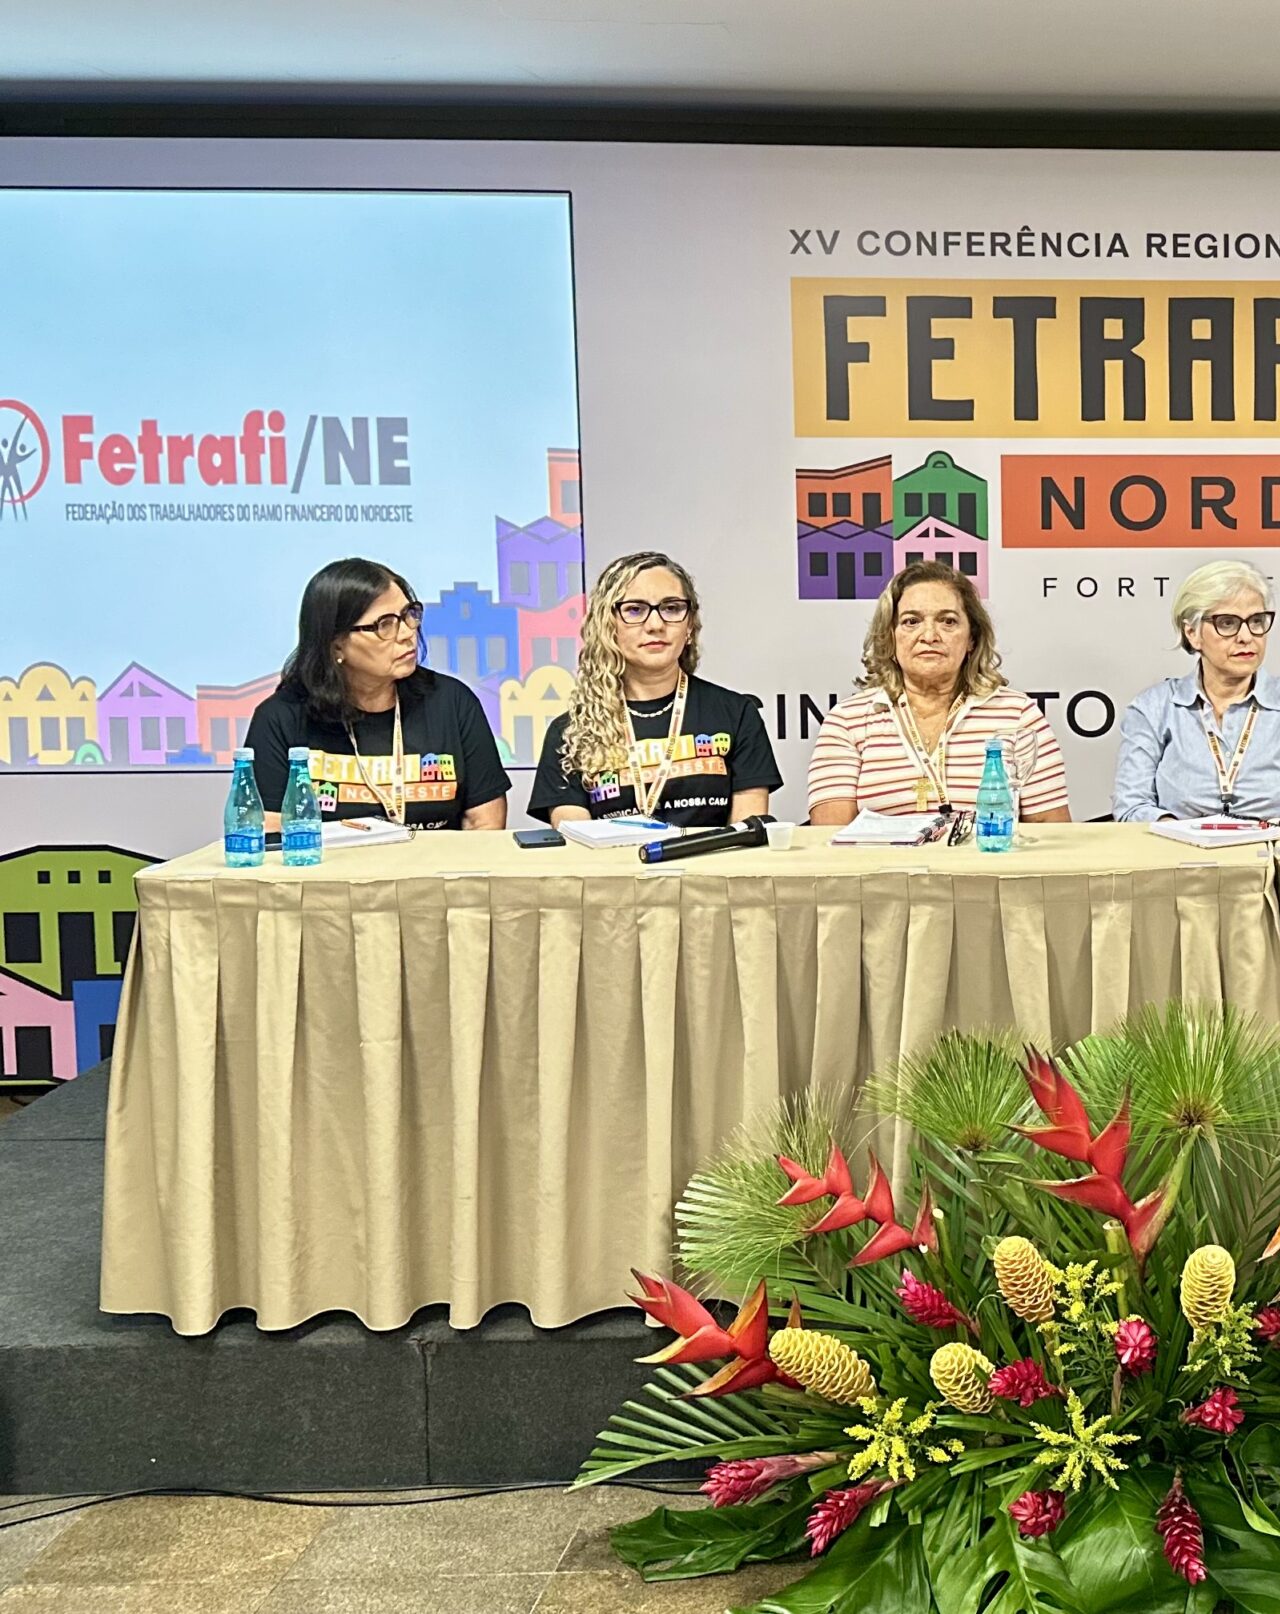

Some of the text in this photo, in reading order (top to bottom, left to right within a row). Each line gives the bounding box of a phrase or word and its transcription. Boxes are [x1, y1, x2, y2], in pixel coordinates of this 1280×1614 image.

[789, 230, 840, 255] XV
[857, 224, 1130, 258] CONFERÊNCIA
[62, 409, 411, 494] Fetrafi/NE
[65, 501, 125, 524] FEDERAÇÃO
[126, 503, 147, 522] DOS
[149, 503, 235, 523] TRABALHADORES
[237, 504, 251, 522] DO
[253, 504, 283, 522] RAMO
[285, 504, 343, 523] FINANCEIRO
[345, 505, 359, 523] DO
